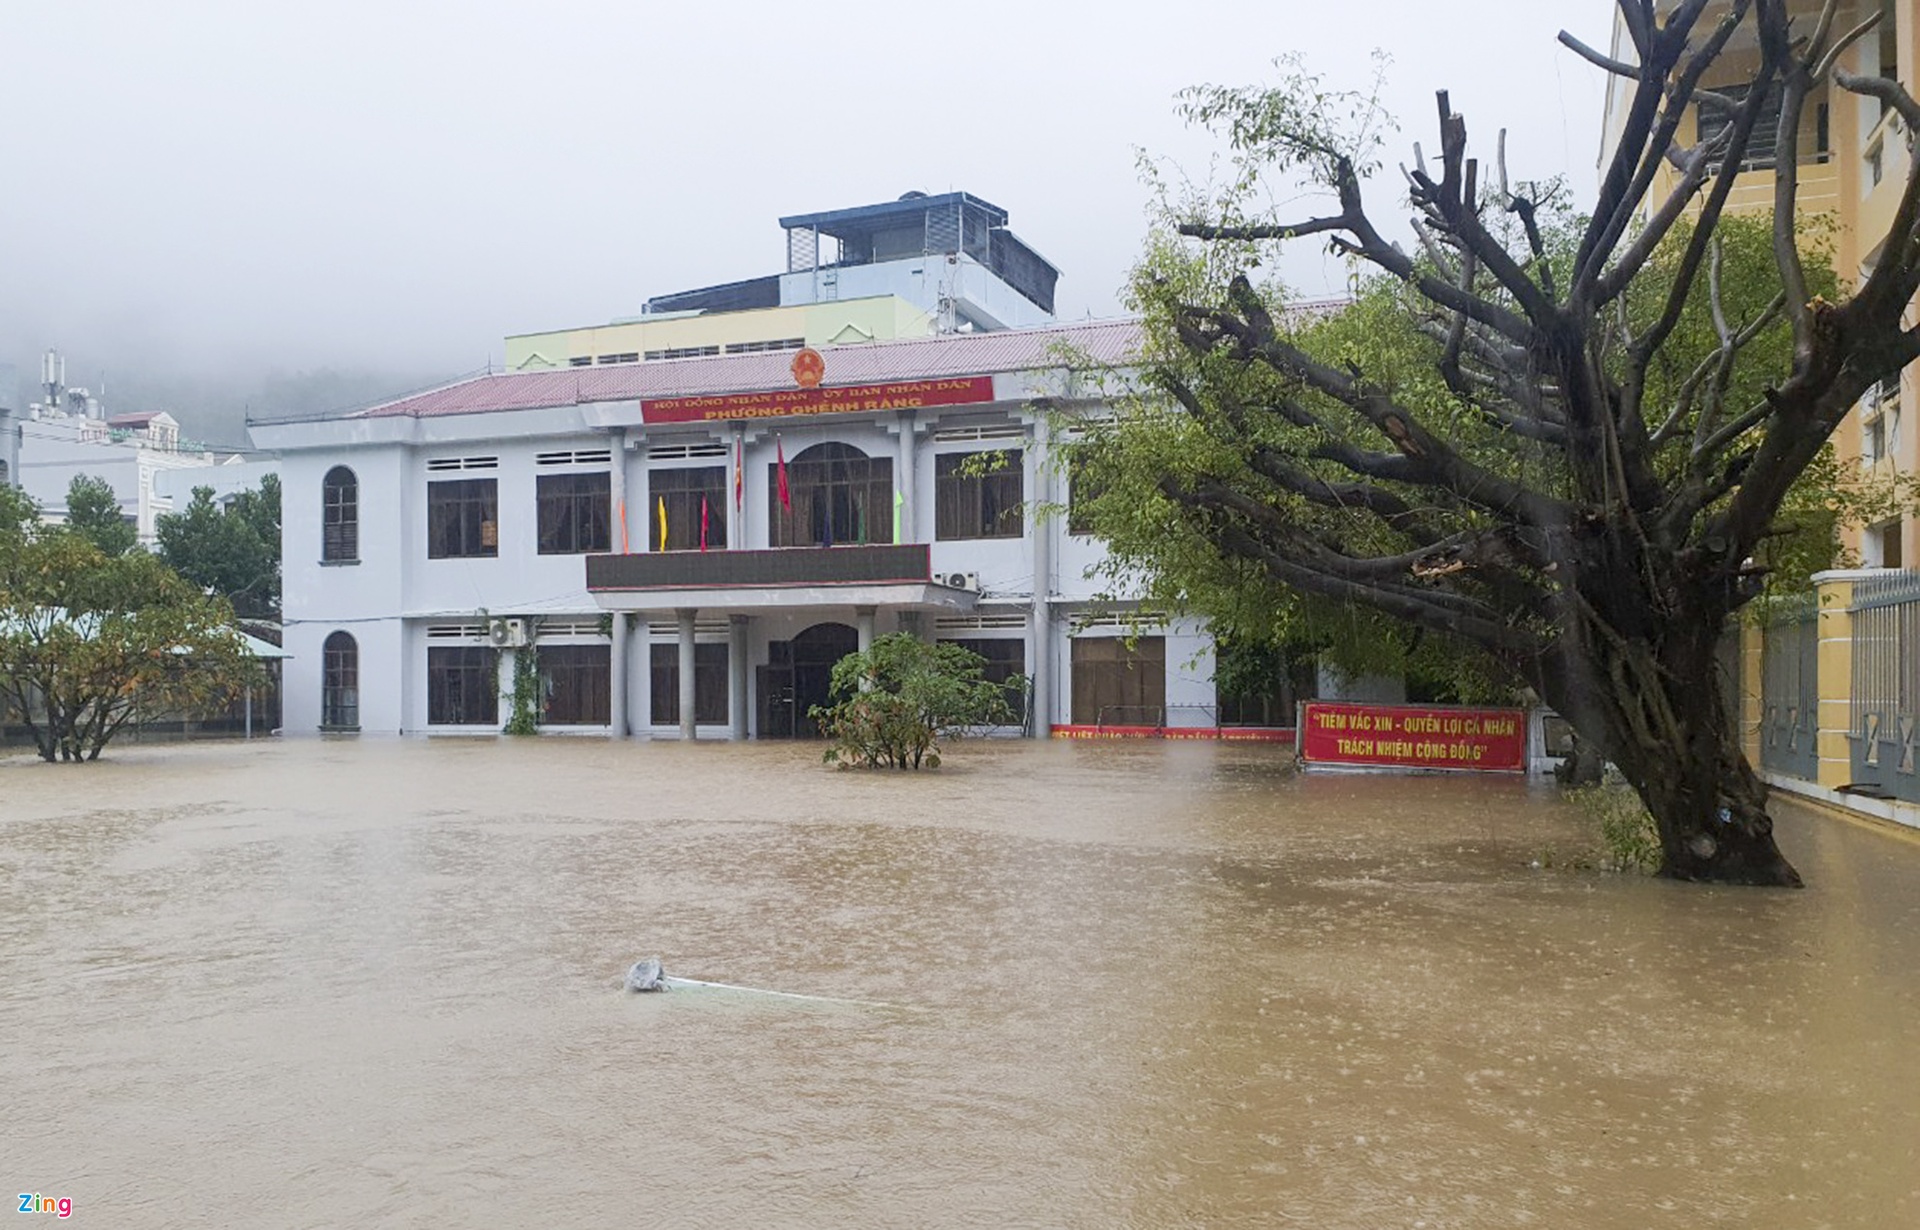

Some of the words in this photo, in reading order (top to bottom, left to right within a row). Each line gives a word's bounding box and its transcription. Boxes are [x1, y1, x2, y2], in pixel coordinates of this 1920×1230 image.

[850, 386, 881, 397] BAN
[1374, 716, 1392, 731] XIN
[1337, 736, 1374, 755] TRÁCH
